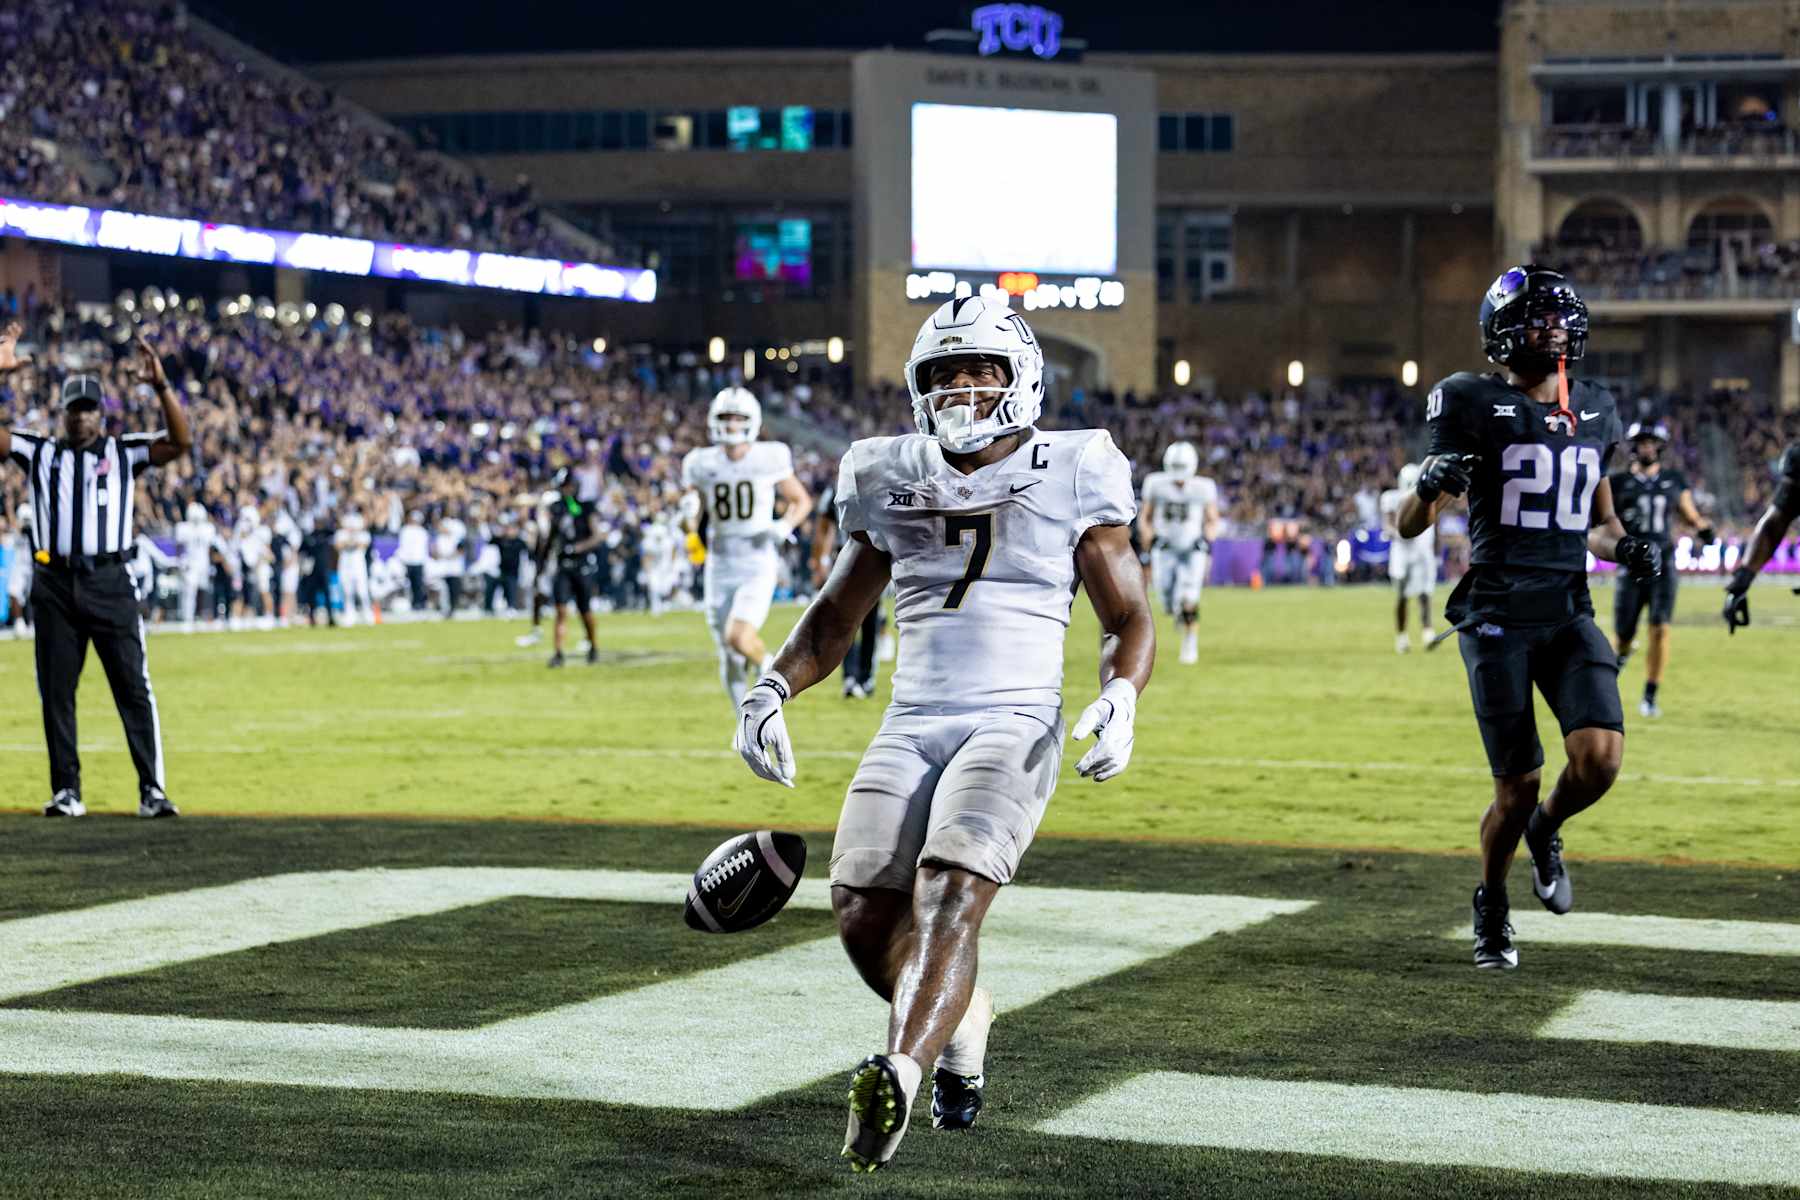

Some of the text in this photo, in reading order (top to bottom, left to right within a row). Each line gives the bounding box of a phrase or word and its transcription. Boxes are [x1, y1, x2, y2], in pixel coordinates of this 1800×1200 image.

[971, 3, 1063, 59] TCU
[1031, 443, 1050, 469] C
[714, 480, 754, 521] 80
[887, 491, 916, 507] XII
[1499, 443, 1601, 531] 20
[1636, 494, 1667, 533] 11
[943, 511, 995, 611] 7
